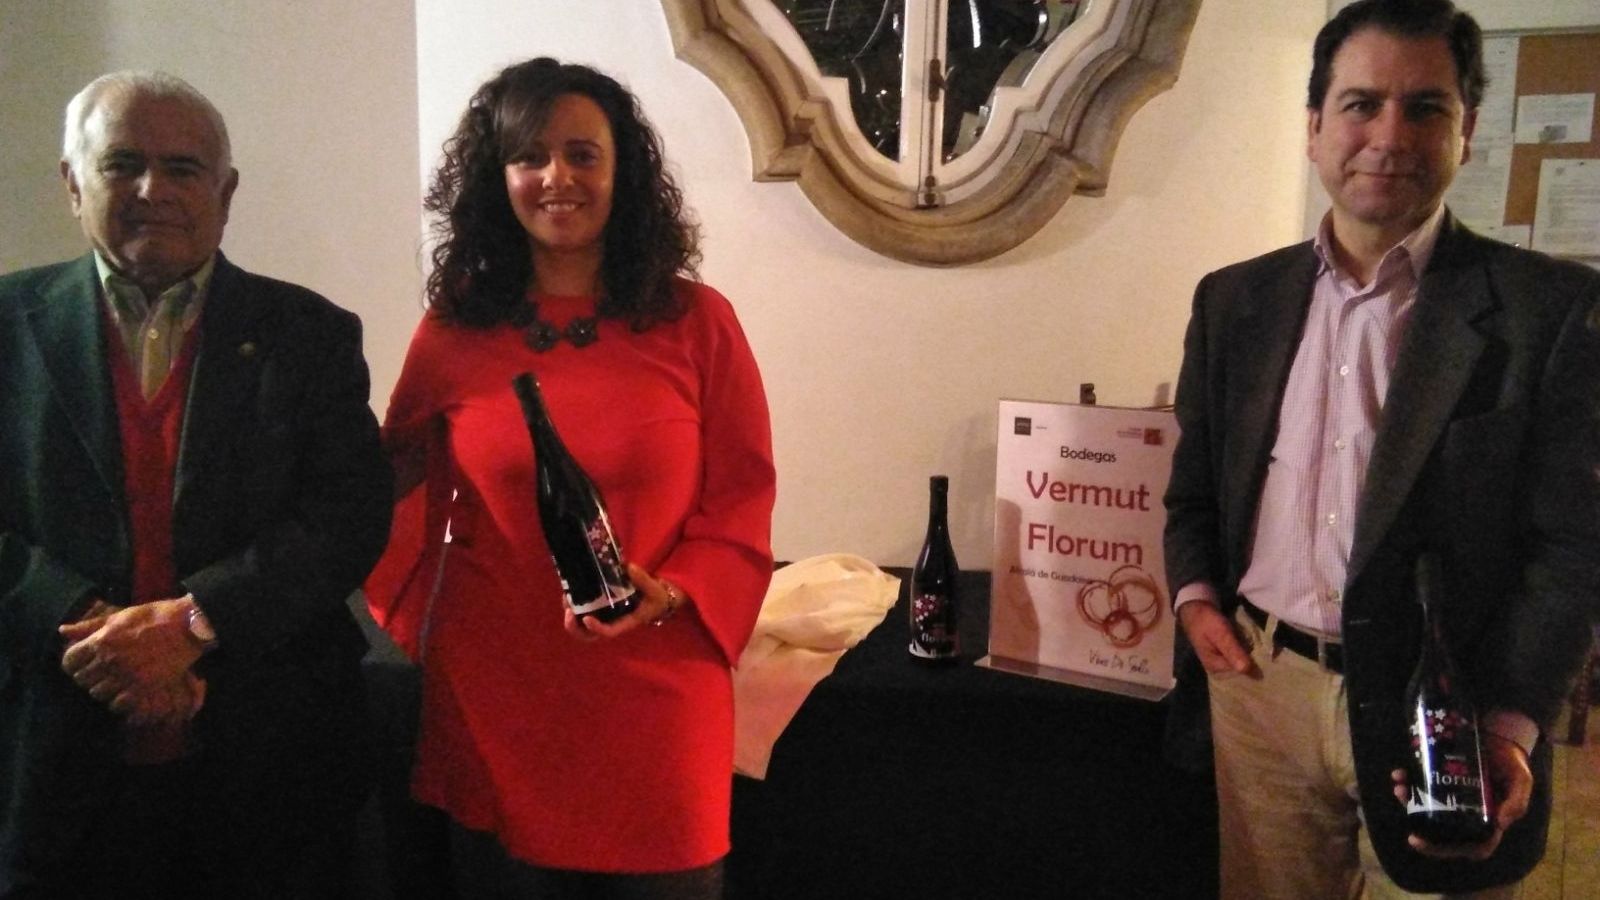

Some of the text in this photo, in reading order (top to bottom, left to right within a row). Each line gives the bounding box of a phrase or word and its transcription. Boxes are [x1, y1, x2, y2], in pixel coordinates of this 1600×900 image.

[1060, 446, 1117, 463] Bodegas
[1026, 470, 1150, 512] Vermut
[1028, 523, 1143, 565] Florum
